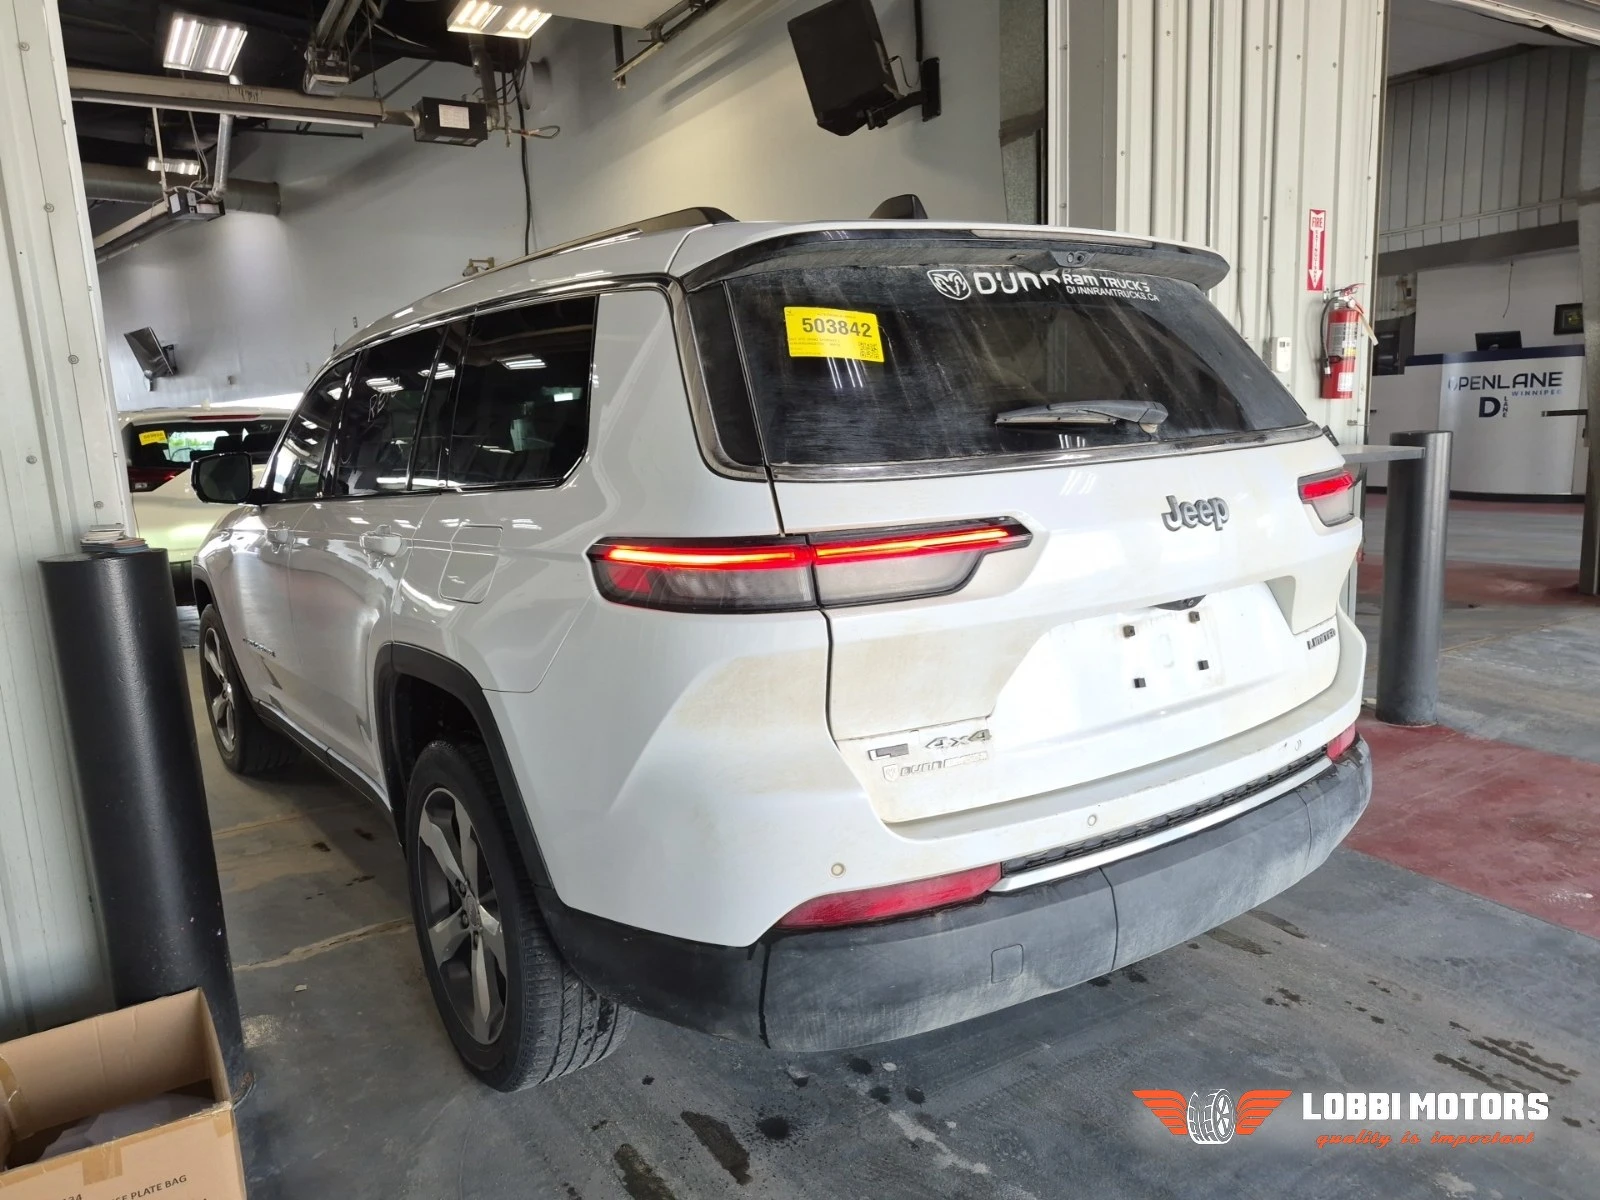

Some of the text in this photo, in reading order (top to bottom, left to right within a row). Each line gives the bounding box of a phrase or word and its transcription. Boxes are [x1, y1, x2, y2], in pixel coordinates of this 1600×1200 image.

[1312, 217, 1323, 228] FIRE
[1100, 276, 1151, 292] TRUCKS
[802, 317, 872, 338] 503842
[1479, 396, 1501, 418] D
[1161, 495, 1229, 532] Jeep
[131, 1183, 162, 1199] PLATE
[165, 1175, 187, 1188] BAG
